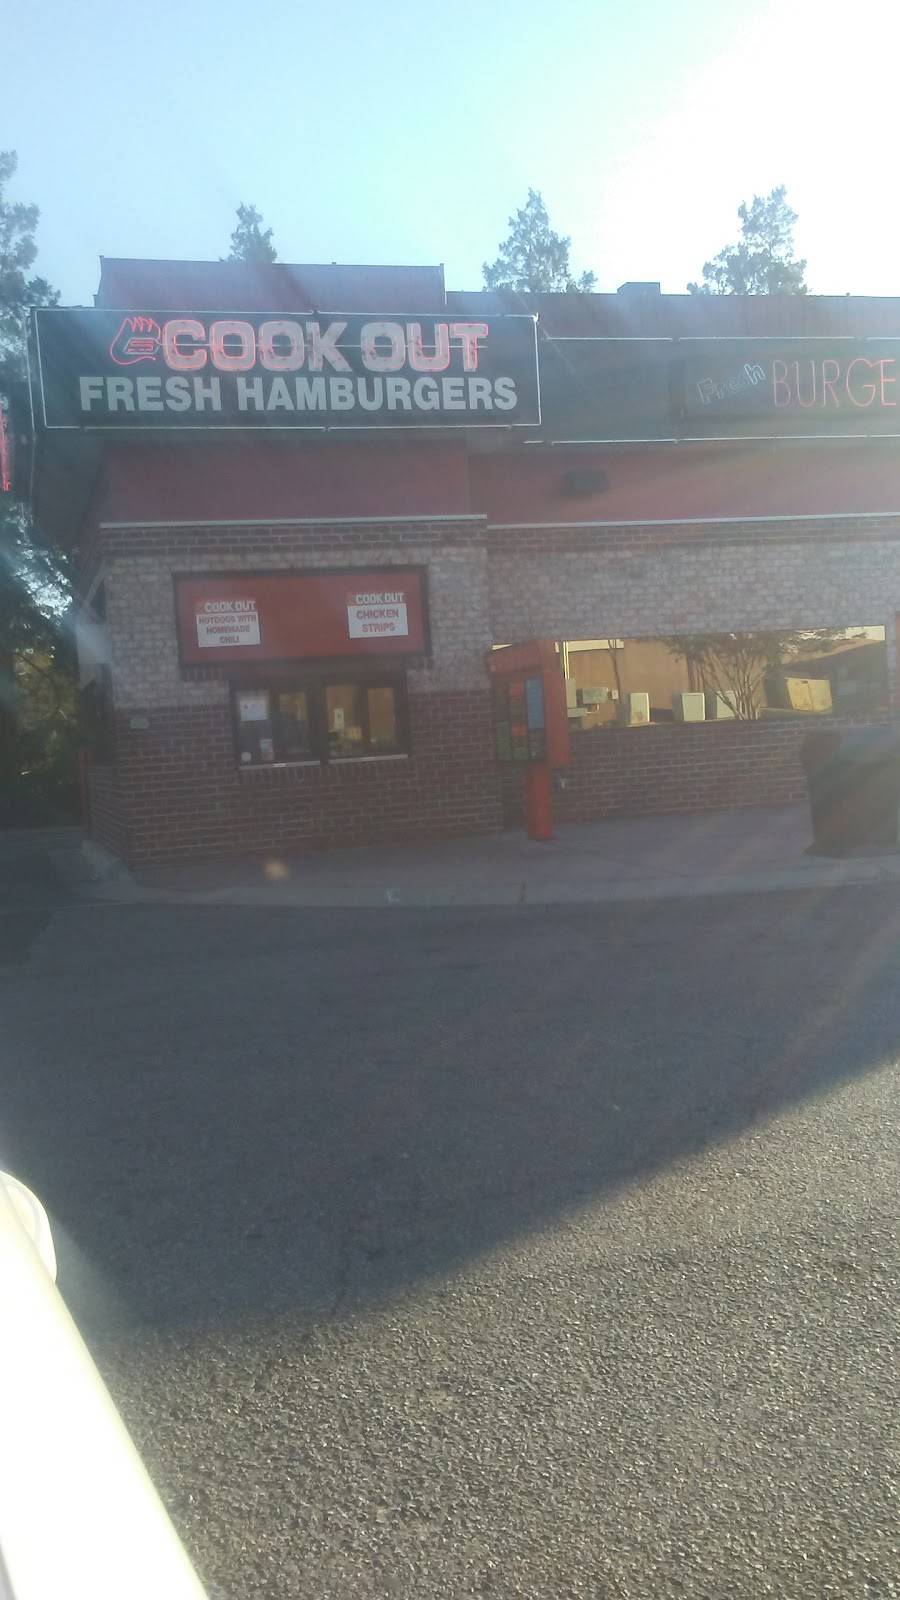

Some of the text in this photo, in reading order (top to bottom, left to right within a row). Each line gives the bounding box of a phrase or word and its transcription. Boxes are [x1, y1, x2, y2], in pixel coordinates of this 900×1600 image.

[163, 319, 489, 372] COOK OUT
[79, 376, 518, 413] FRESH HAMBURGERS
[355, 591, 404, 605] COOK OUT
[204, 599, 256, 613] COOK OUT
[237, 614, 257, 623] WITH
[356, 610, 400, 620] CHICKEN
[206, 625, 251, 635] HOMEMADE
[361, 622, 396, 632] STRIPS
